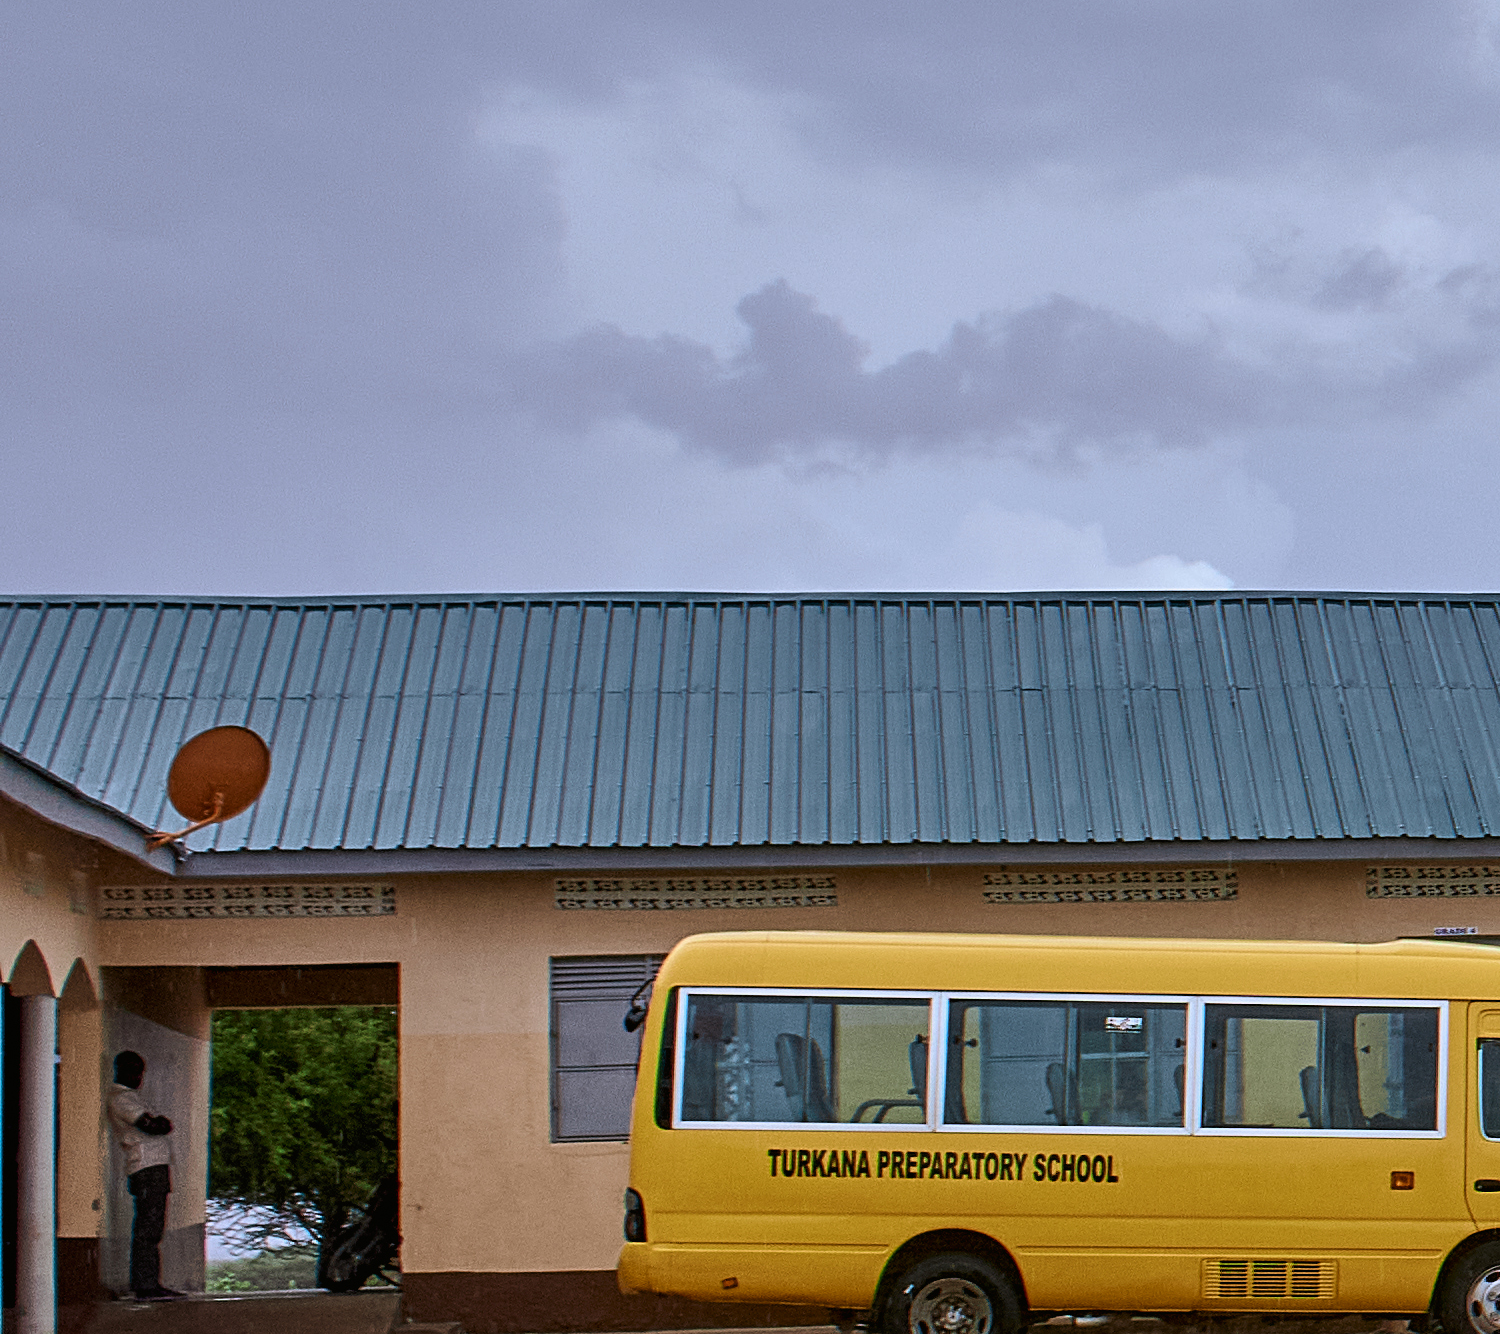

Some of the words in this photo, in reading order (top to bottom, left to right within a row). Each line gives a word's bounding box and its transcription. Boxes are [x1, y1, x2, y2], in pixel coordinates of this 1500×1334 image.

[767, 1149, 871, 1178] TURKANA
[876, 1150, 1028, 1181] PREPARATORY
[1032, 1153, 1119, 1183] SCHOOL
